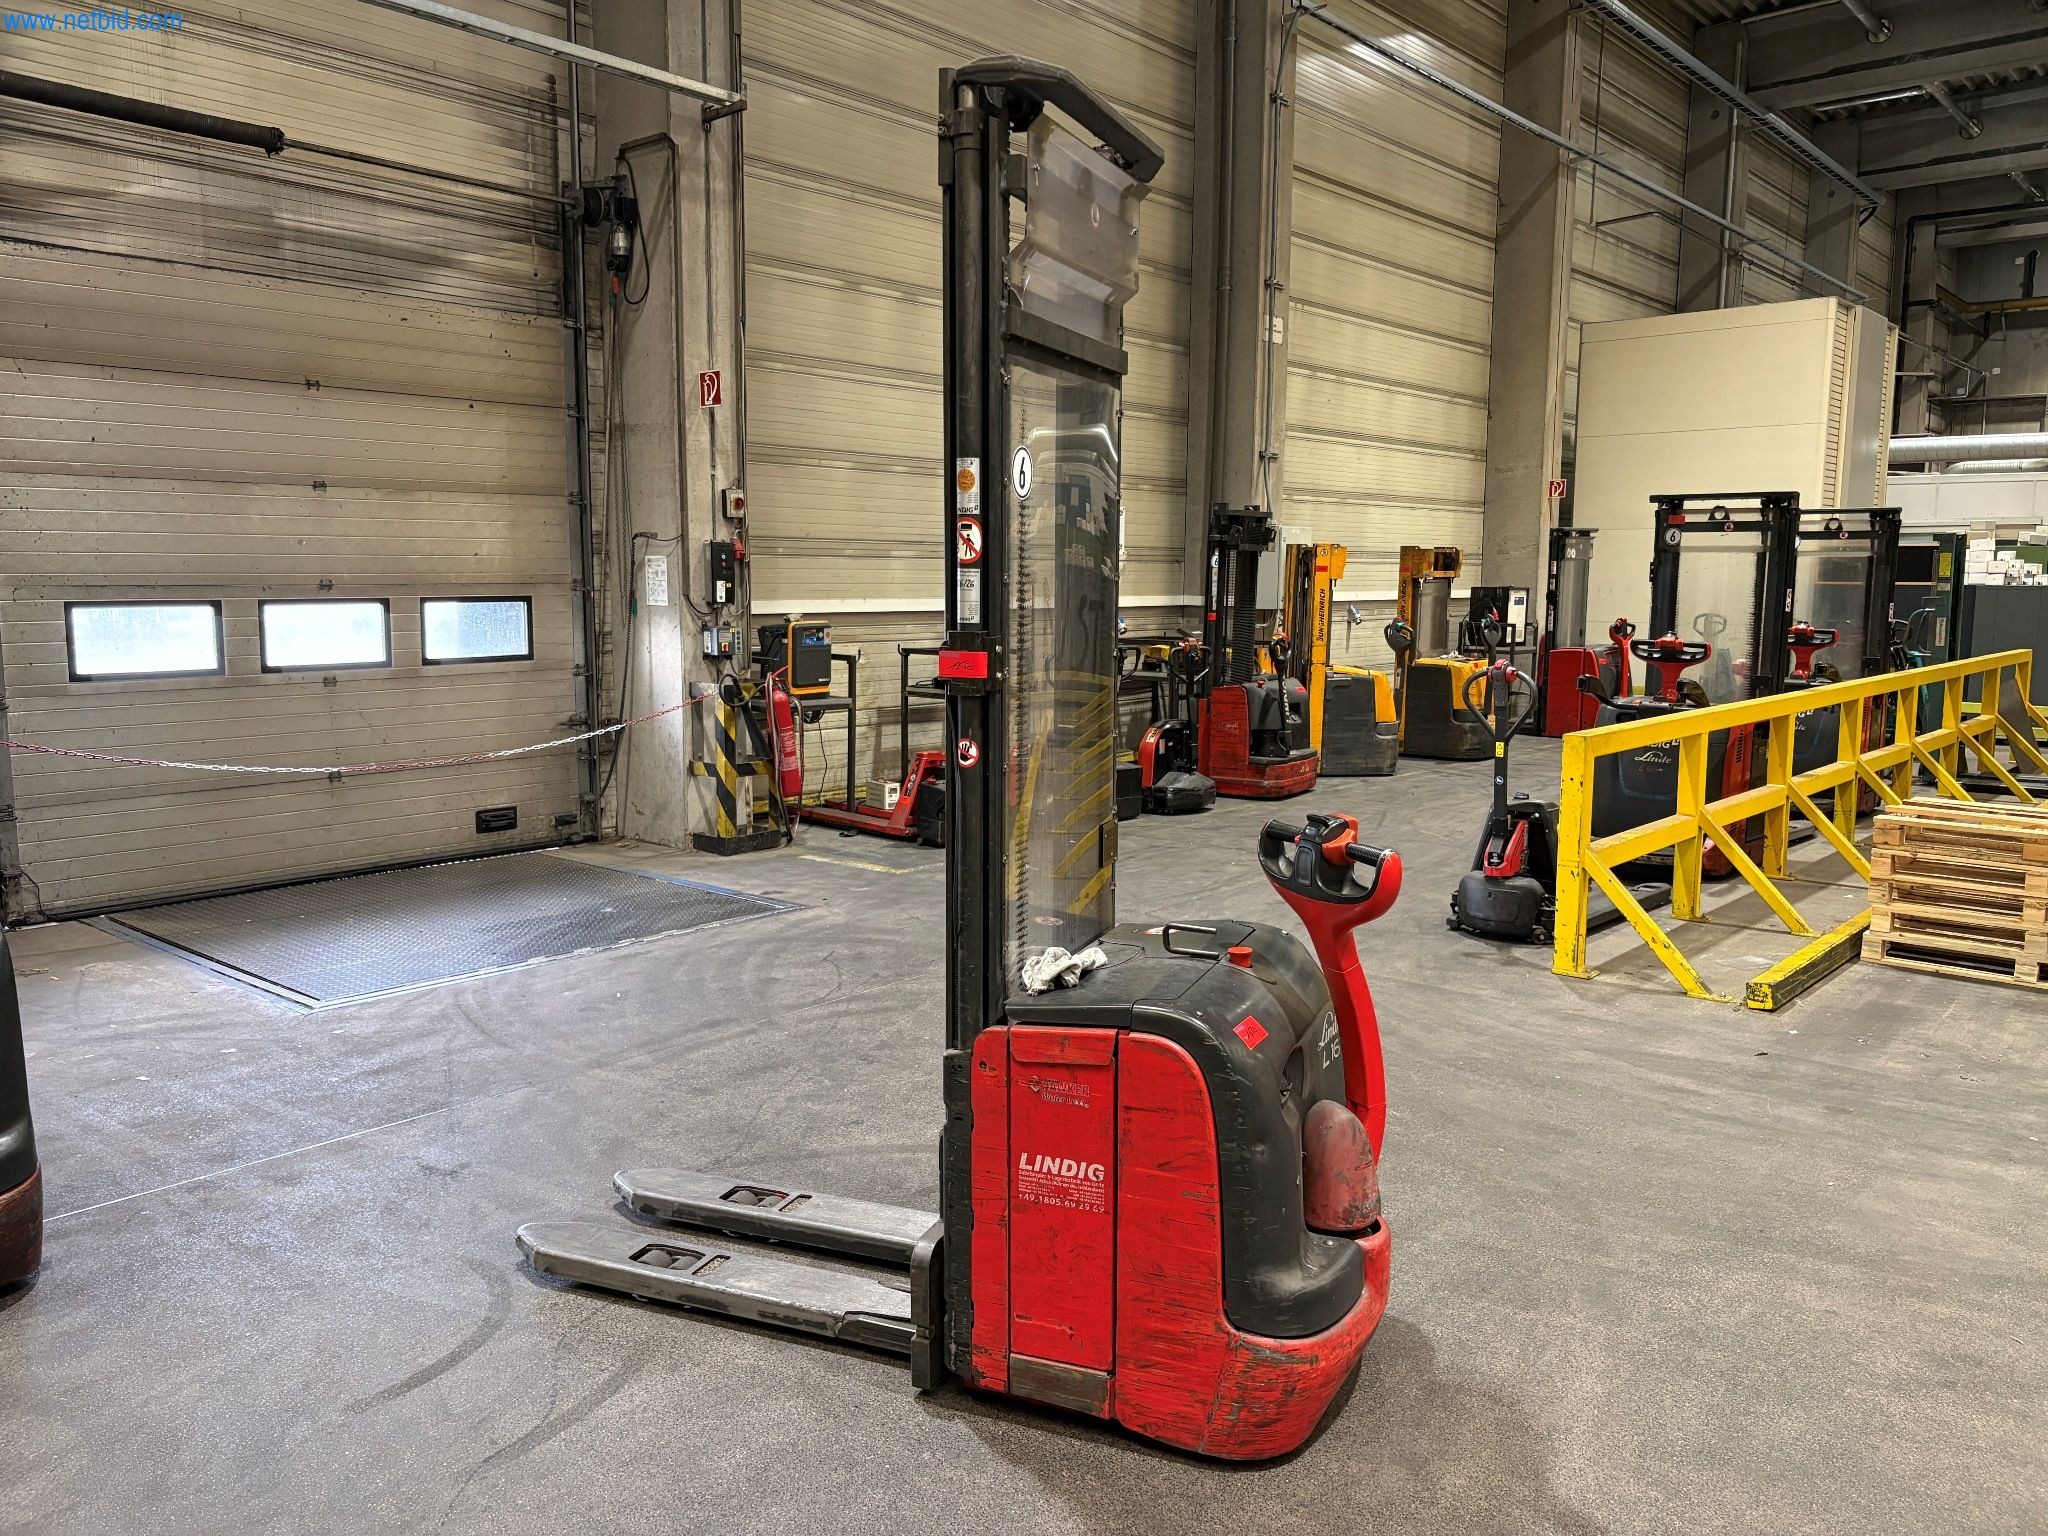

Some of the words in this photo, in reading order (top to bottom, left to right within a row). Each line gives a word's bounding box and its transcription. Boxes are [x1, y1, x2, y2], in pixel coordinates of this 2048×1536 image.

[1018, 456, 1026, 490] 6
[1634, 750, 1672, 764] Linde
[1019, 1152, 1105, 1182] LINDIG
